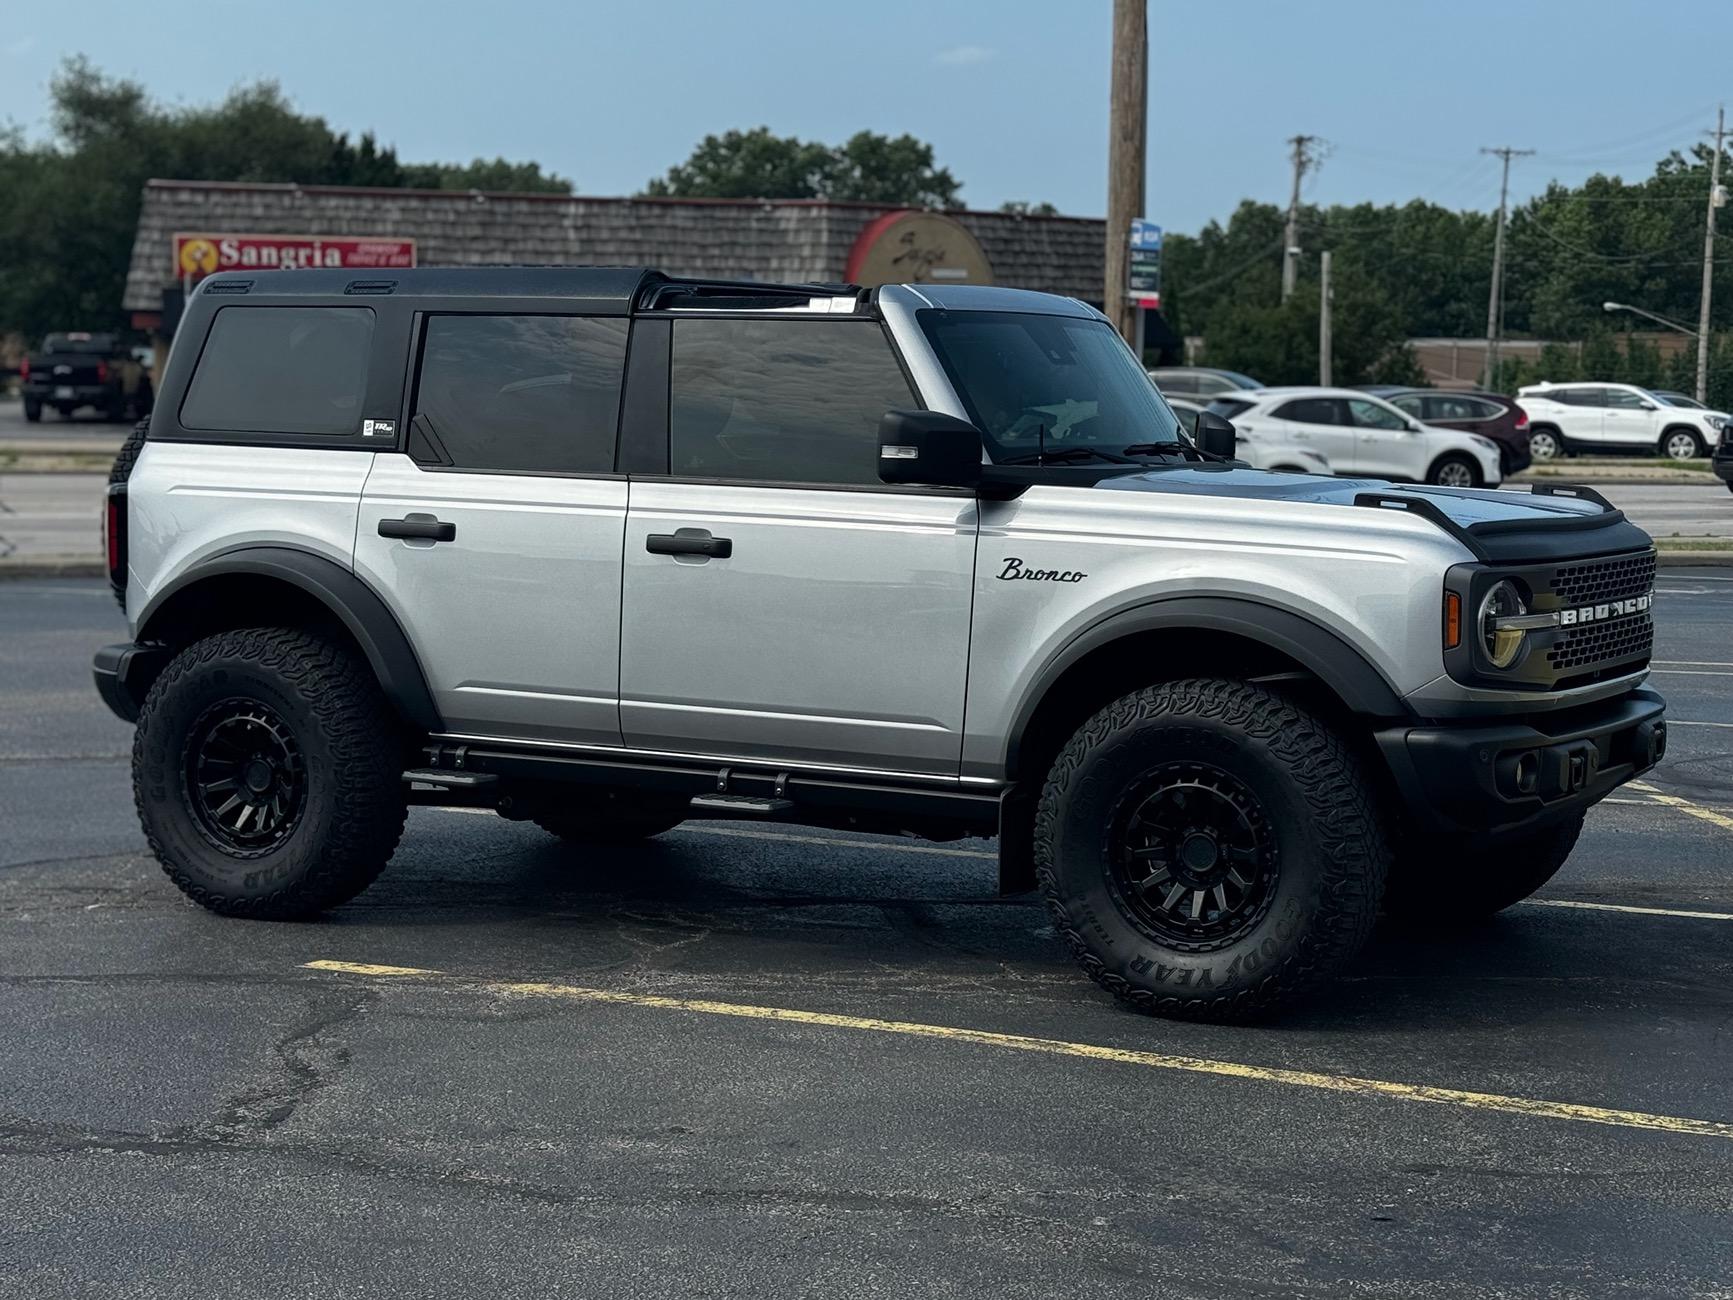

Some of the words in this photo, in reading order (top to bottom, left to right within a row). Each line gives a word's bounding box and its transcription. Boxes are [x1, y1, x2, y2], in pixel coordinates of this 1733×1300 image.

[219, 239, 343, 270] Sangria
[995, 557, 1088, 583] Bronco
[1560, 596, 1649, 625] BRONCO
